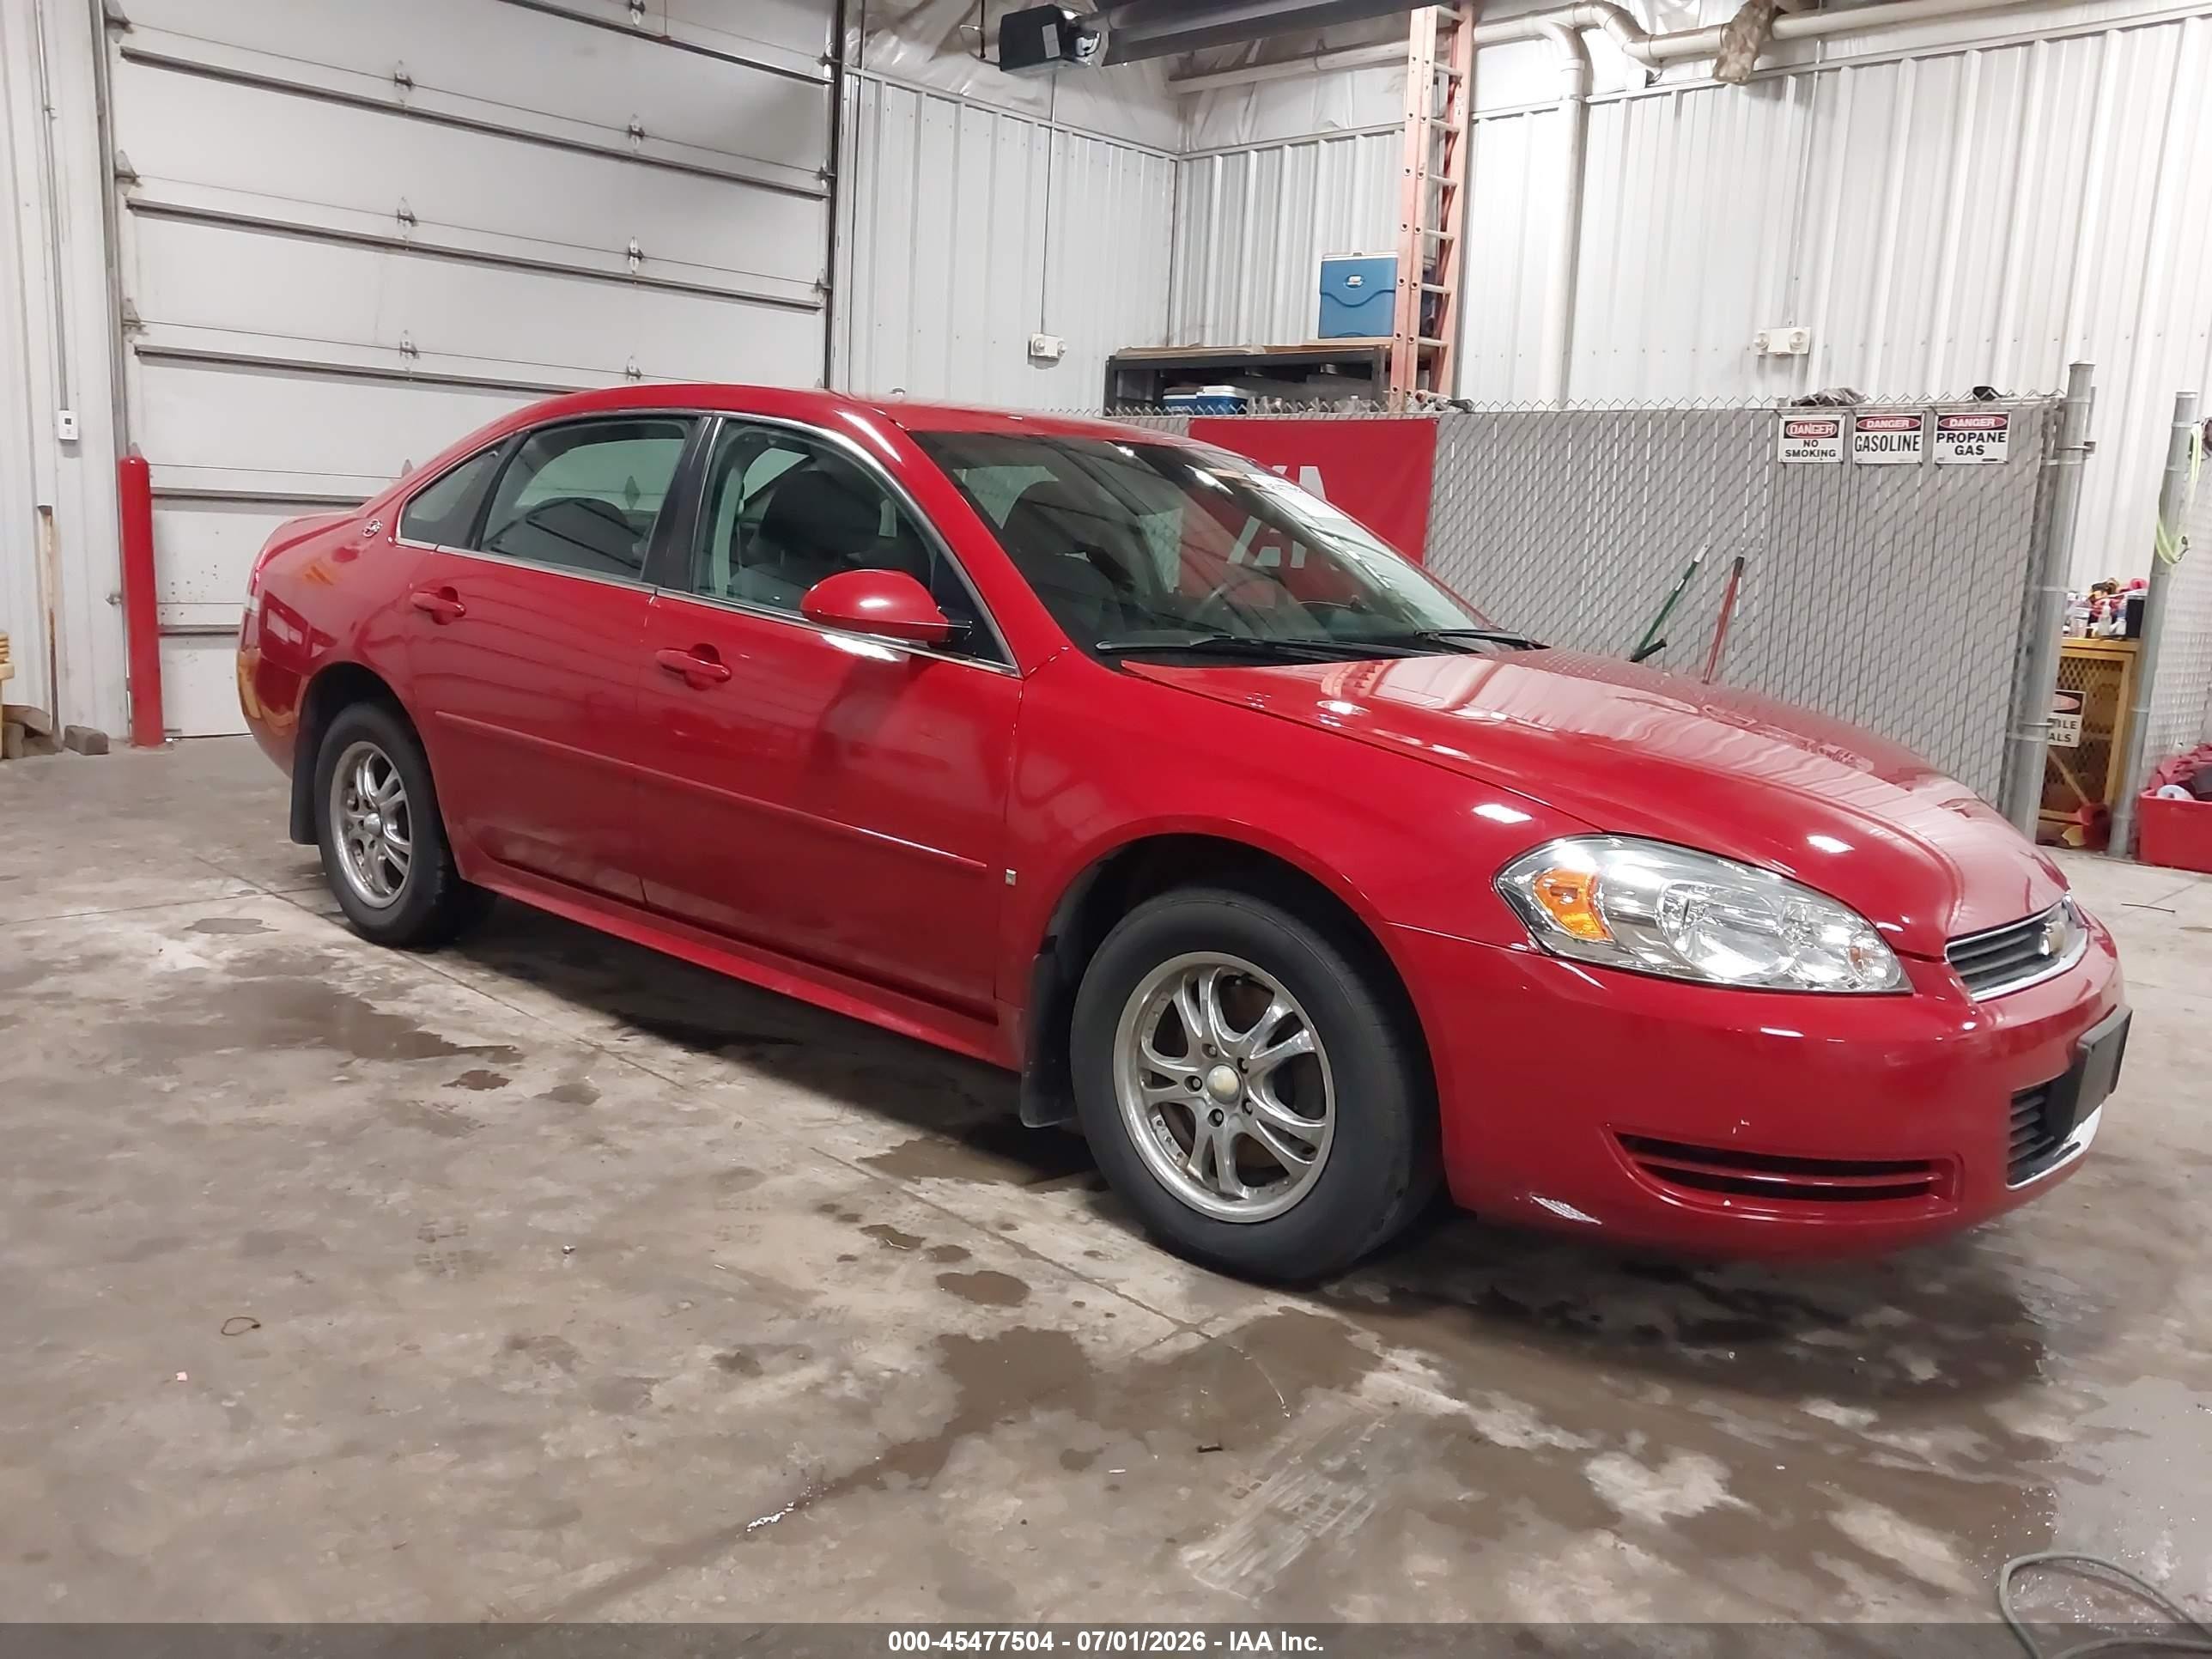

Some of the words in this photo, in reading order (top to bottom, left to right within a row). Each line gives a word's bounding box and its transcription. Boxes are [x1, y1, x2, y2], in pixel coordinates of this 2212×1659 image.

[1790, 423, 1833, 434] DANGER
[1867, 419, 1910, 428] DANGER
[1949, 418, 1996, 428] DANGER
[1854, 434, 1921, 452] GASOLINE
[1936, 432, 2007, 444] PROPANE
[1784, 449, 1837, 458] SMOKING
[1954, 445, 1985, 456] GAS
